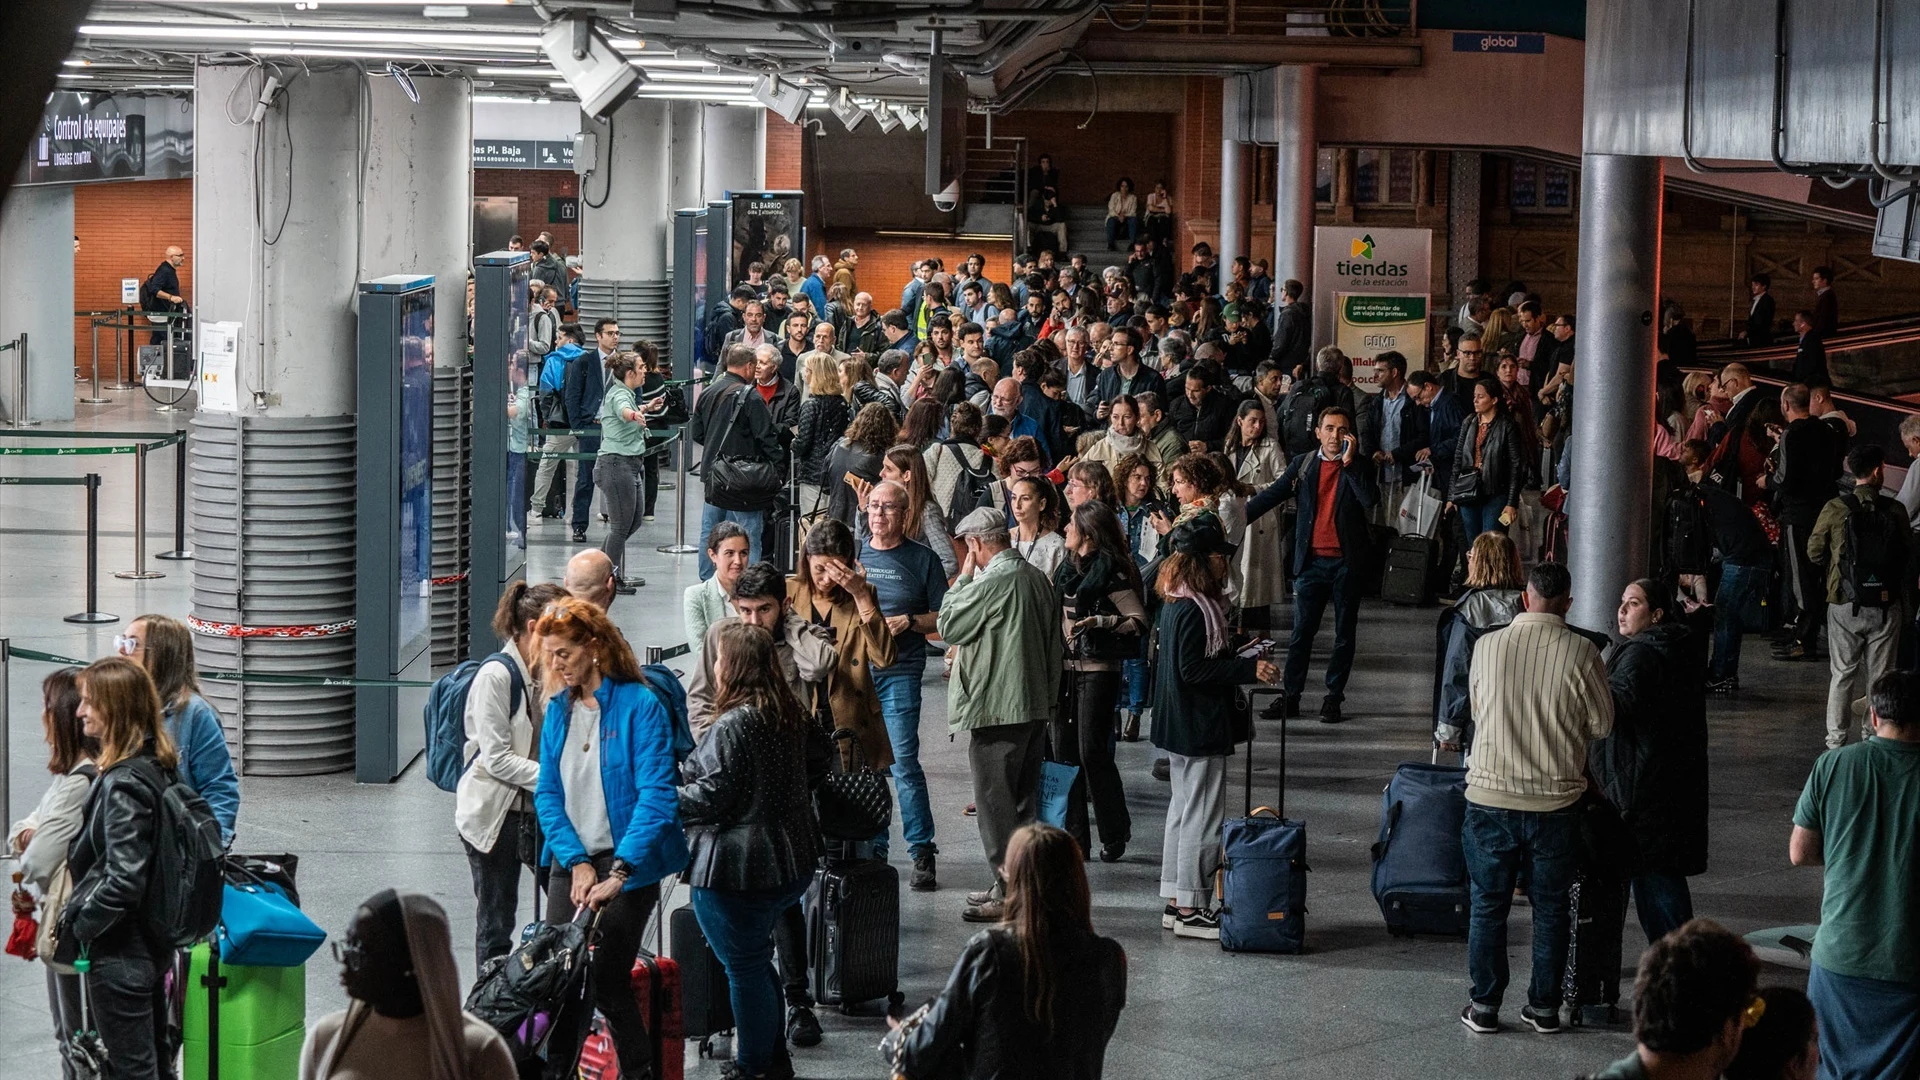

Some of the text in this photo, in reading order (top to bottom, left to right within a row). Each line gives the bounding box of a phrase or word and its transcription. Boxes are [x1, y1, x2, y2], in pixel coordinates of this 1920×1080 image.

[1481, 35, 1517, 51] global
[54, 112, 126, 144] Control de equipajes
[54, 151, 92, 166] LUGGAGE CONTROL
[487, 146, 499, 154] Pl.
[502, 146, 521, 156] Baja
[1336, 260, 1408, 276] tiendas
[1350, 278, 1408, 287] de la estación
[1364, 335, 1397, 348] COMO
